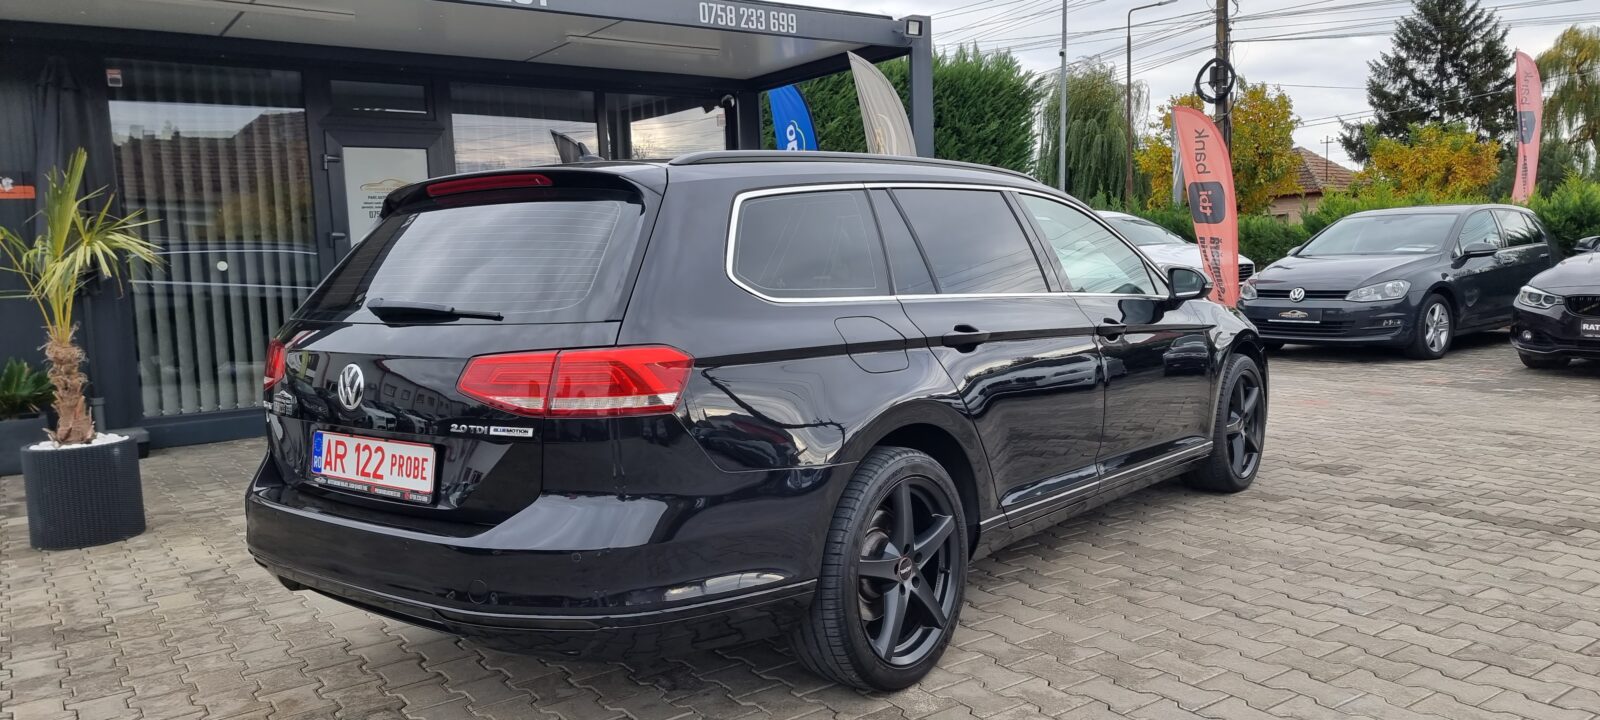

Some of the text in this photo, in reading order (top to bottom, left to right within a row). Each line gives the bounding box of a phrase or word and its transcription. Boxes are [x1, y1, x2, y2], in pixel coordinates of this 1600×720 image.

[699, 2, 797, 33] 0758 233 699
[450, 423, 468, 434] 2.0
[468, 425, 488, 434] TDI
[313, 455, 322, 468] RO
[323, 438, 429, 480] AR 122 PROBE
